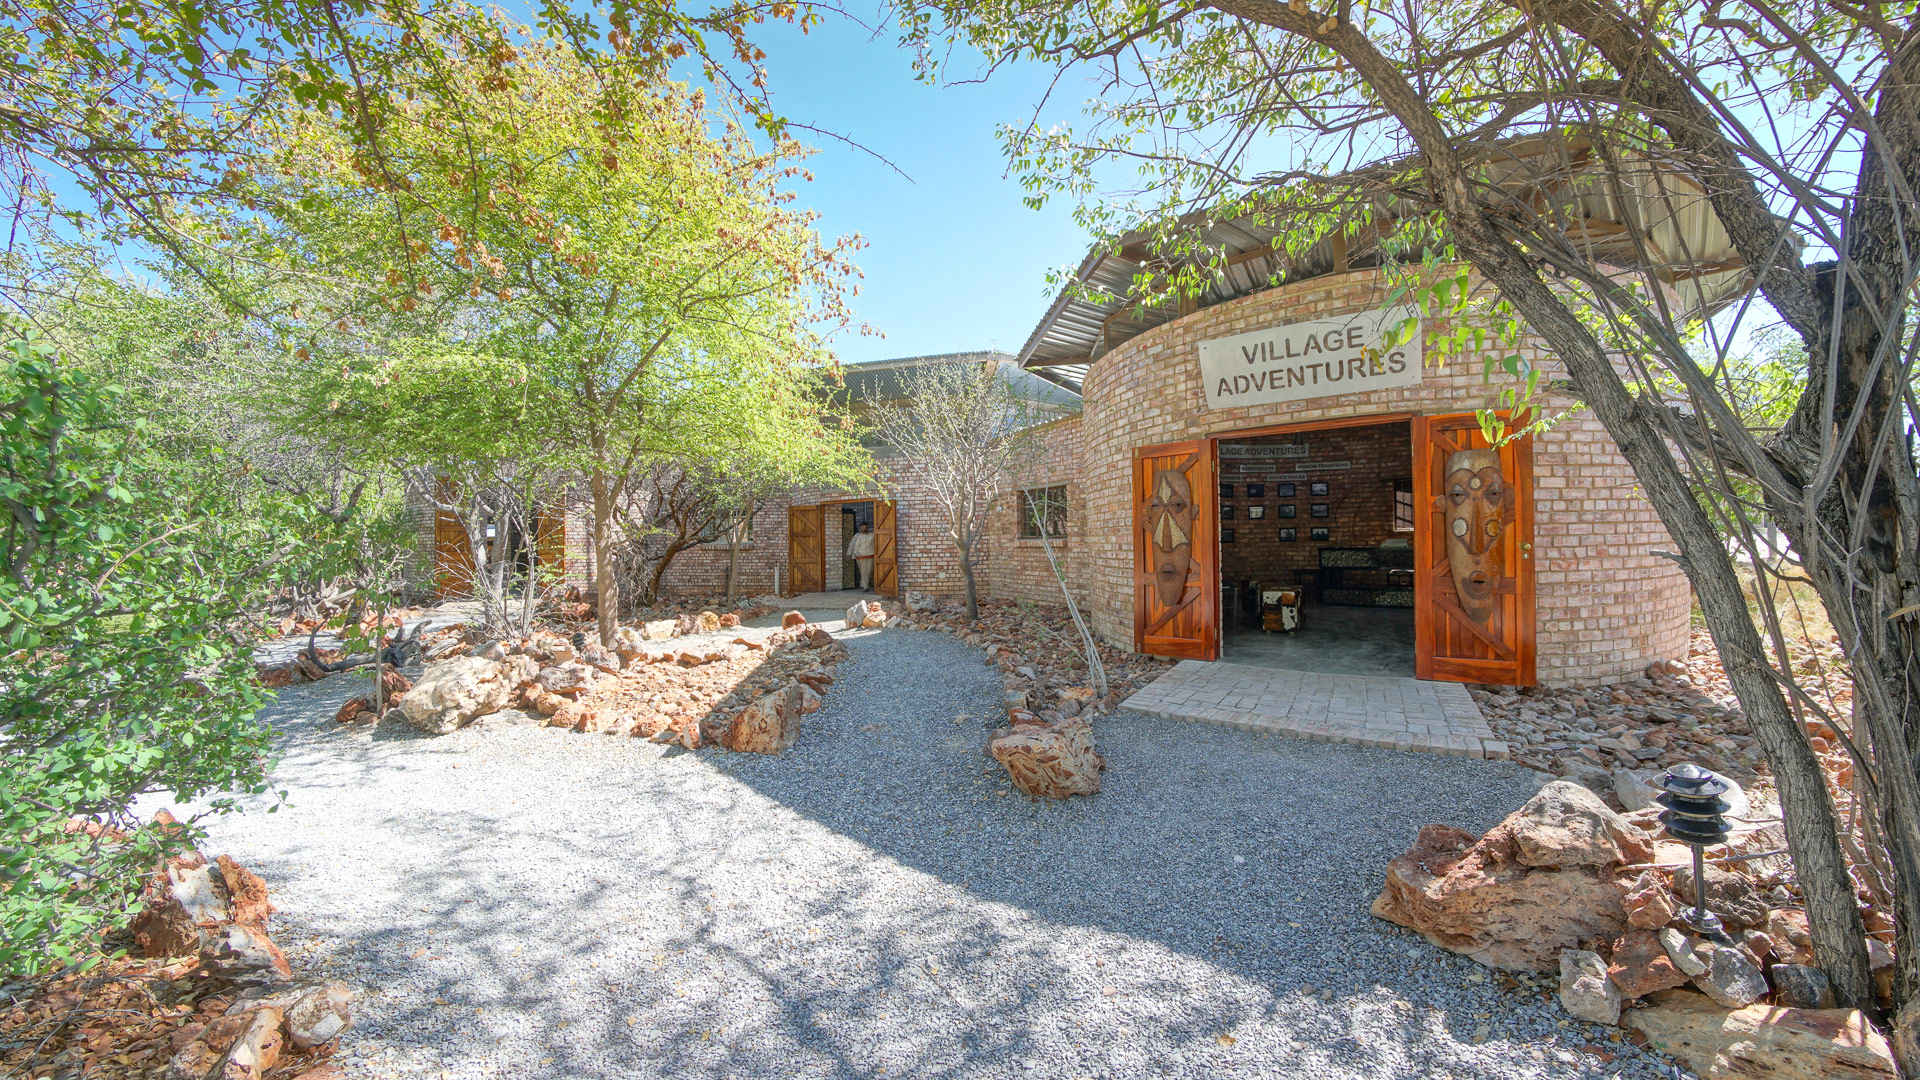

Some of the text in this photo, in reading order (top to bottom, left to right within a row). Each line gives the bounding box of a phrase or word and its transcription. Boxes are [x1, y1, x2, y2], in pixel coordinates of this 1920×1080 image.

[1241, 325, 1365, 365] VILLAGE
[1217, 351, 1407, 397] ADVENTURES
[1244, 446, 1306, 456] ADVENTURES
